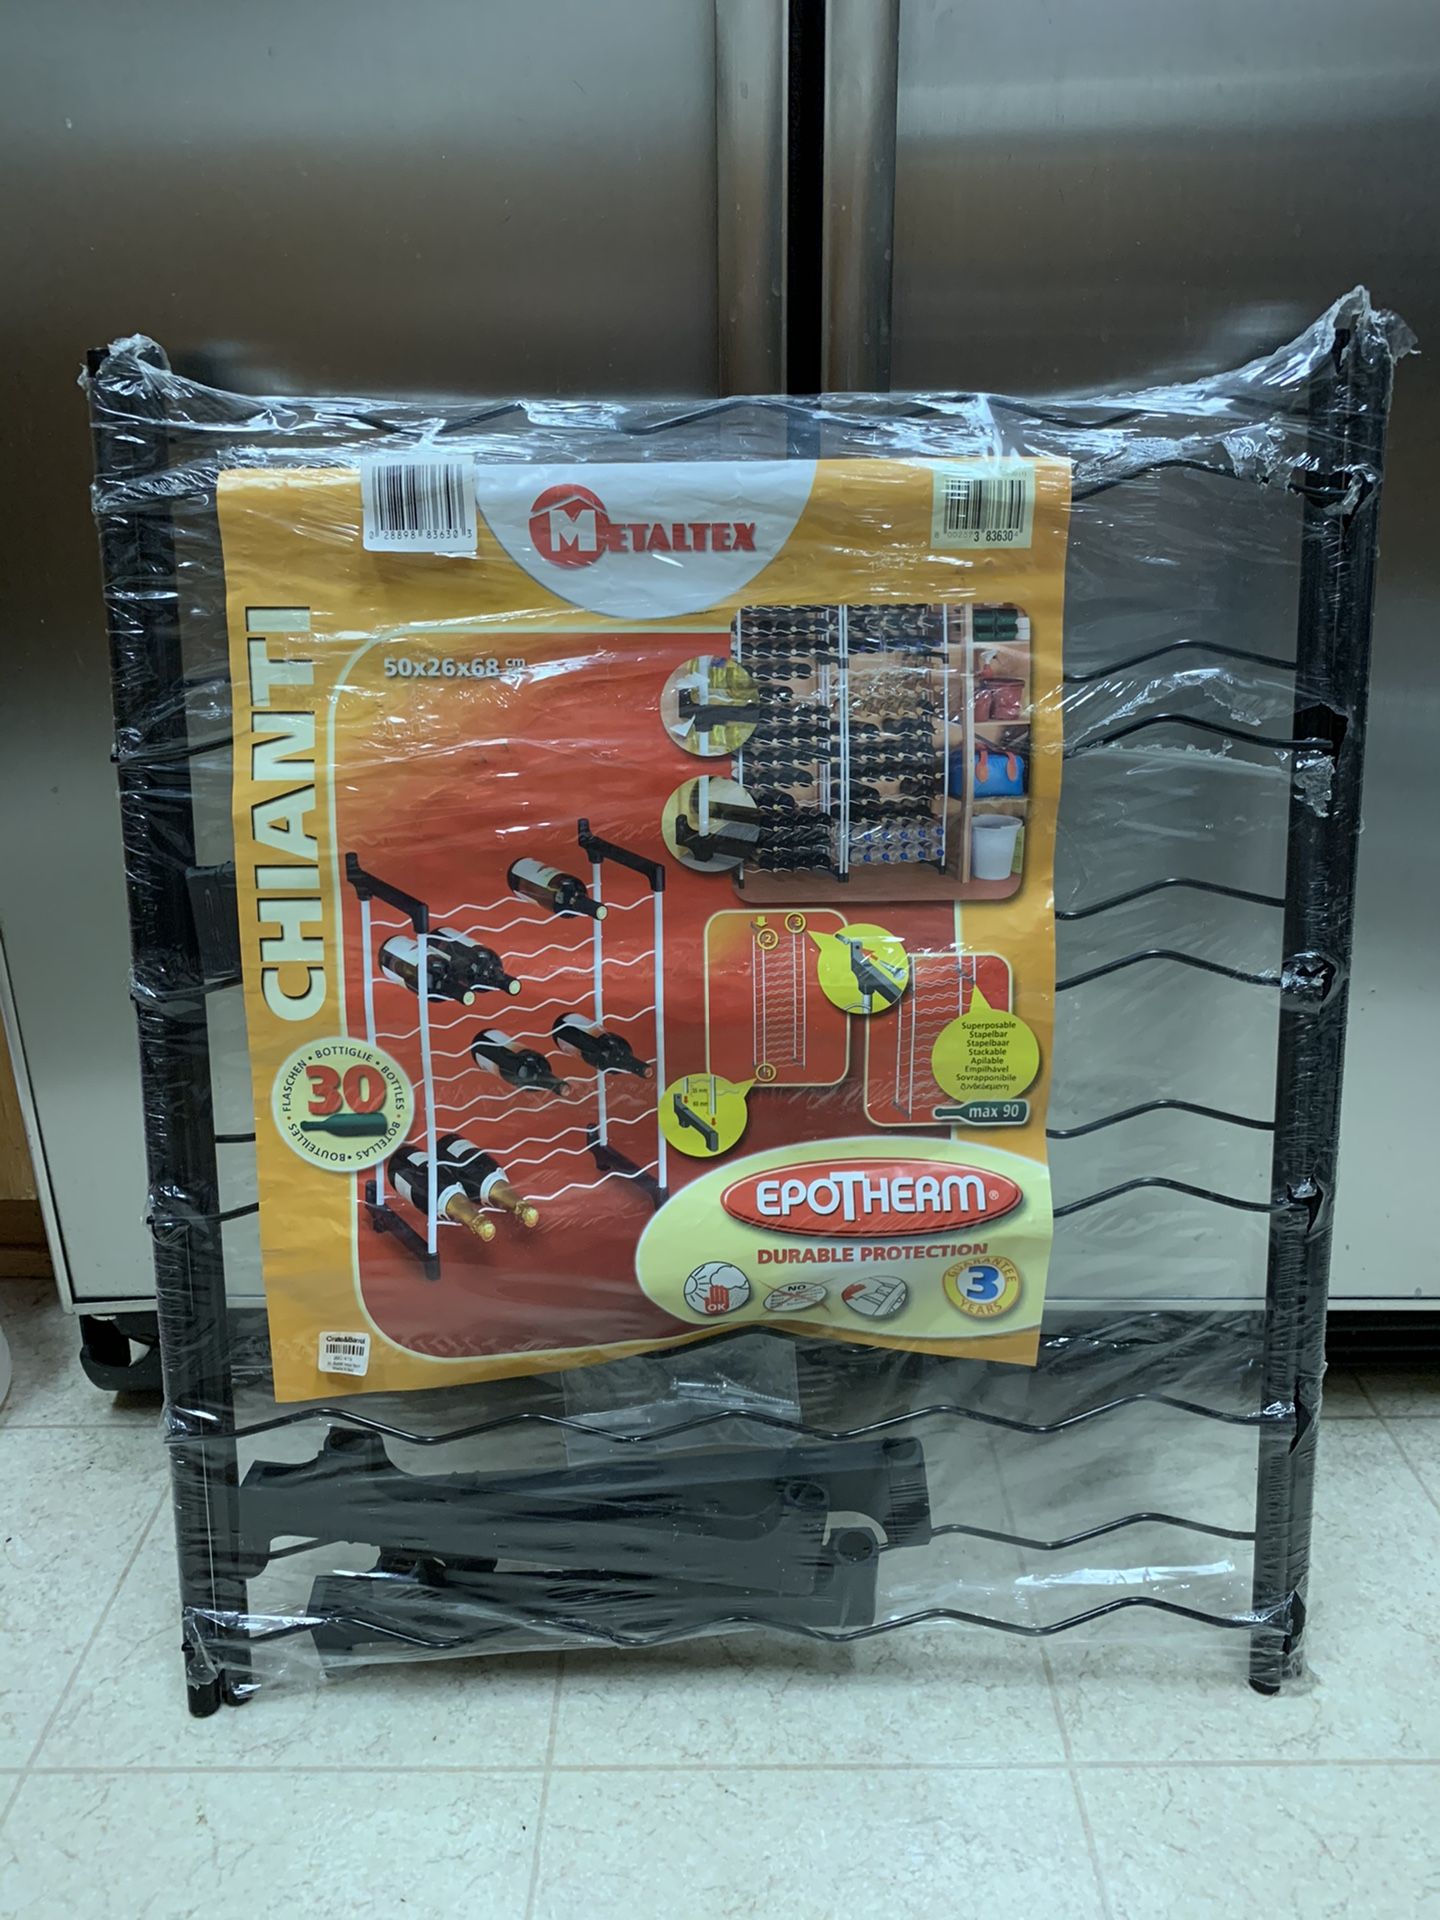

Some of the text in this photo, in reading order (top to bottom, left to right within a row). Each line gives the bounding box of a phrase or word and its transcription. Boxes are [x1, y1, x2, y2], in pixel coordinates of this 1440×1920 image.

[384, 530, 416, 540] 28898
[426, 529, 459, 540] 83630
[549, 508, 758, 553] METALTEX
[383, 656, 526, 678] 50x26x68 cm
[245, 606, 327, 1021] CHIANTI
[795, 917, 802, 927] 3
[765, 934, 772, 943] 2
[961, 1021, 1017, 1030] Superposable
[969, 1030, 1008, 1039] Stapelbar
[966, 1039, 1010, 1048] Stapelbaar
[968, 1048, 1007, 1056] Stackable
[970, 1057, 1005, 1065] Apilable
[964, 1065, 1010, 1074] Empilhável
[956, 1073, 1017, 1082] Sovrapponibile
[305, 1064, 388, 1117] 30
[282, 1046, 406, 1162] FLASCHEN BOTTIGLIE BOTTLES BOTELLAS BOUTEILLES
[969, 1104, 1020, 1118] max 90
[757, 1243, 989, 1265] DURABLE PROTECTION
[947, 1257, 1017, 1282] GUARANTEE
[788, 1284, 806, 1292] NO
[966, 1265, 1000, 1301] 3
[707, 1303, 726, 1311] OK
[960, 1299, 1002, 1315] YEARS
